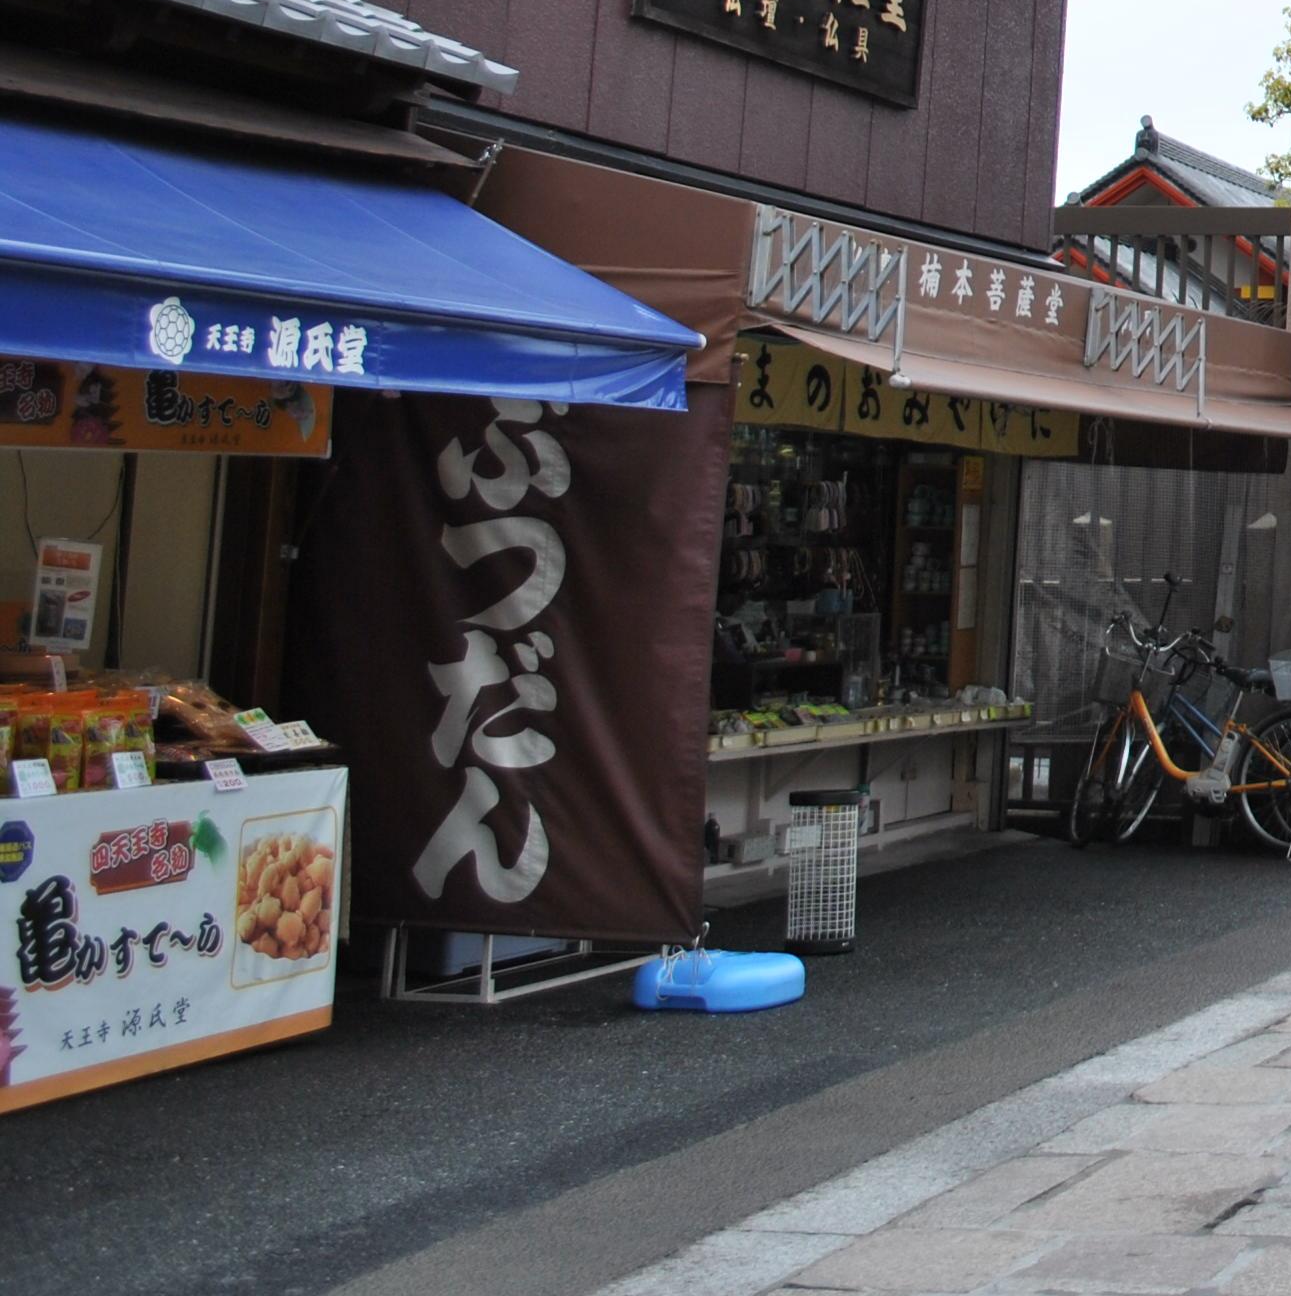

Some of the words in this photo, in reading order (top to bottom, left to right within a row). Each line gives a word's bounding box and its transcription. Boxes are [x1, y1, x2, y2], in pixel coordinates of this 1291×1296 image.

[919, 252, 1064, 326] 楠本菩薩堂
[206, 323, 255, 354] 天王寺
[268, 315, 368, 376] 源氏堂
[91, 819, 168, 873] 四天王寺
[151, 845, 189, 881] 名物
[58, 1020, 111, 1050] 天王寺
[121, 998, 191, 1037] 源氏堂
